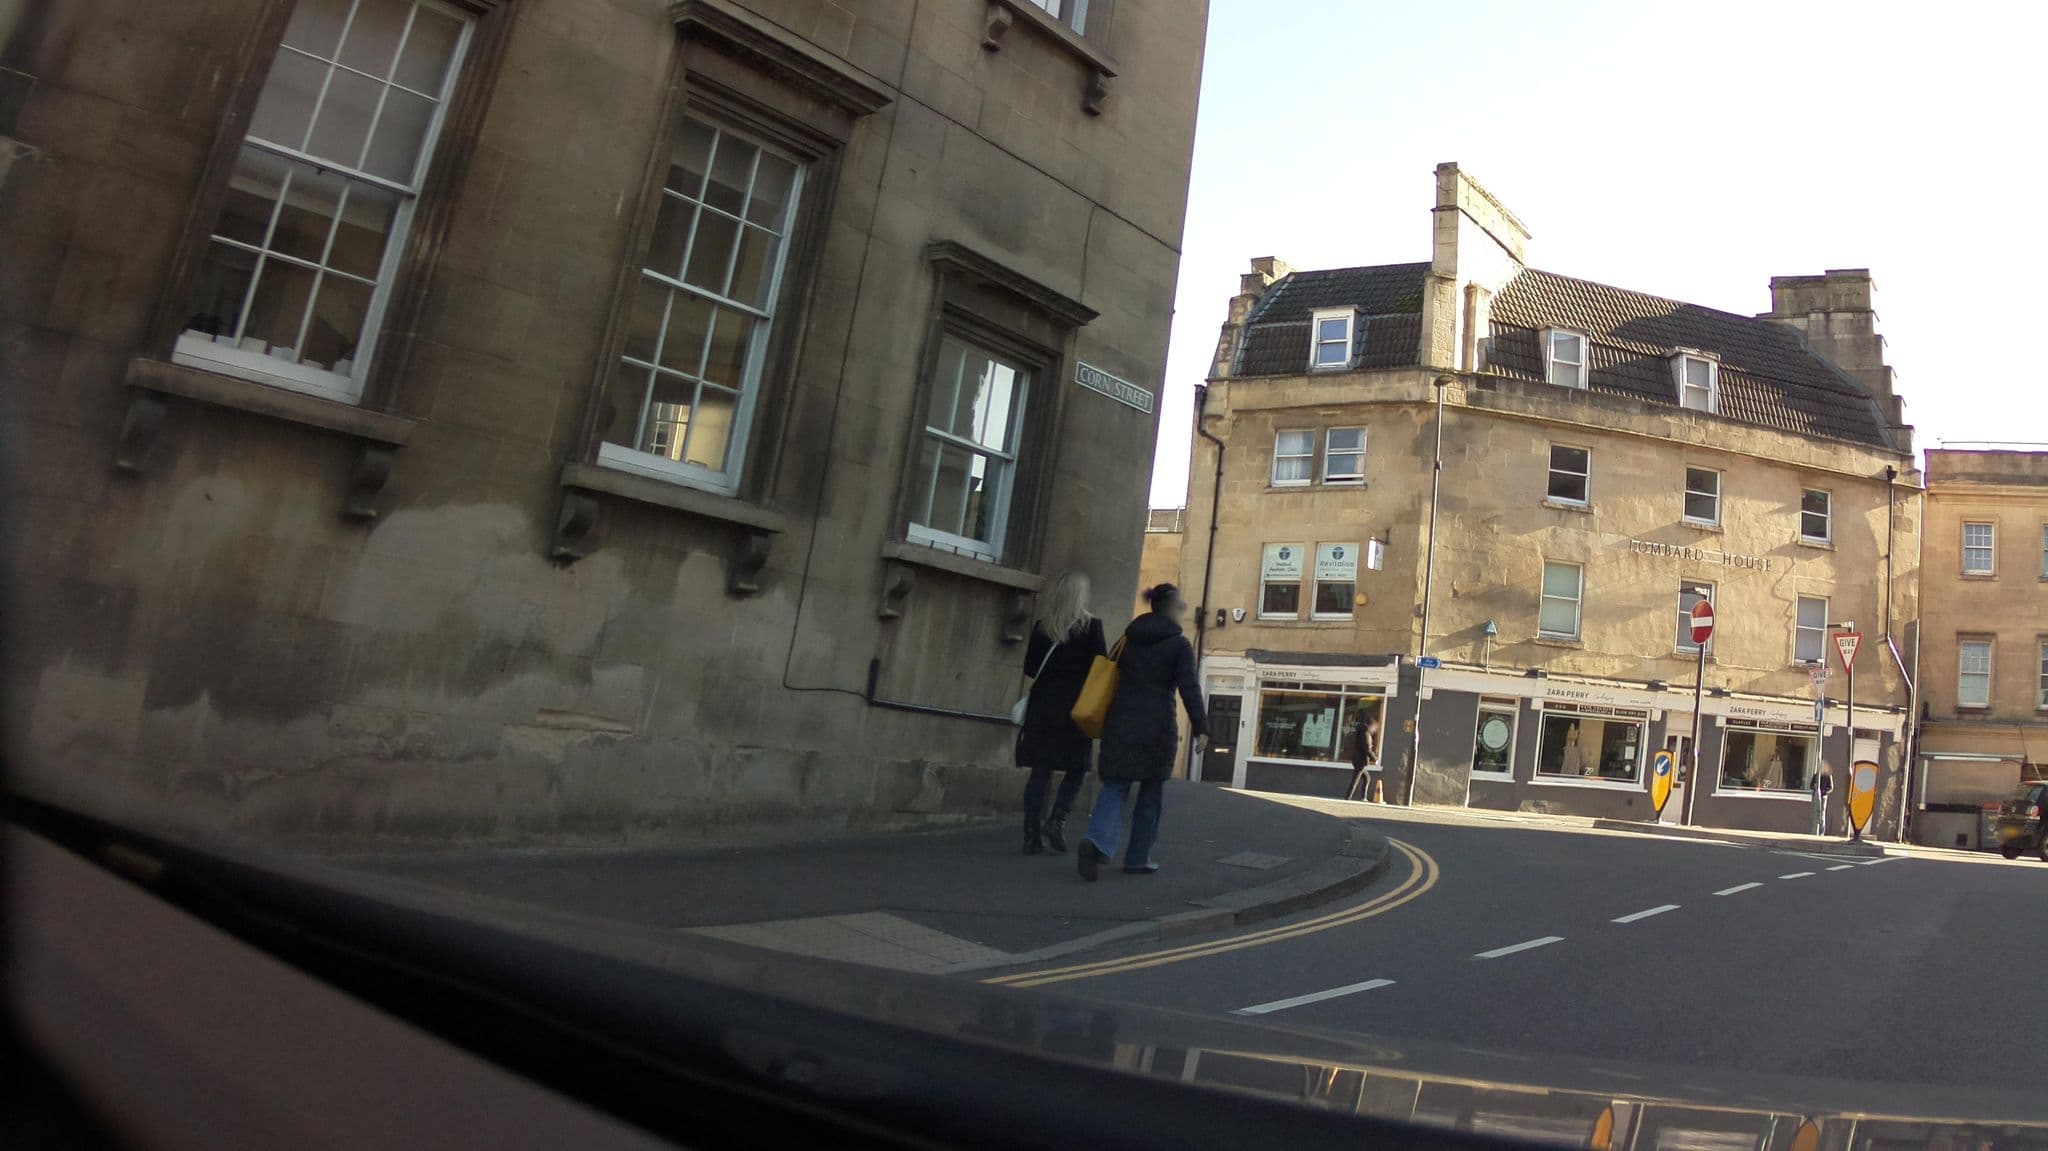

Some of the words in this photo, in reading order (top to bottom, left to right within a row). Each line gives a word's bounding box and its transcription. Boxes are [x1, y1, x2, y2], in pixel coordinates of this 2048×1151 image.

[1080, 367, 1111, 391] CORN
[1114, 382, 1151, 409] STREET
[1629, 540, 1704, 561] LOMBARD
[1722, 552, 1773, 572] HOUSE
[1839, 638, 1856, 647] GIVE
[1546, 688, 1566, 697] ZARA
[1566, 690, 1590, 699] PERRY
[1729, 706, 1747, 714] ZARA
[1747, 708, 1767, 716] PERRY
